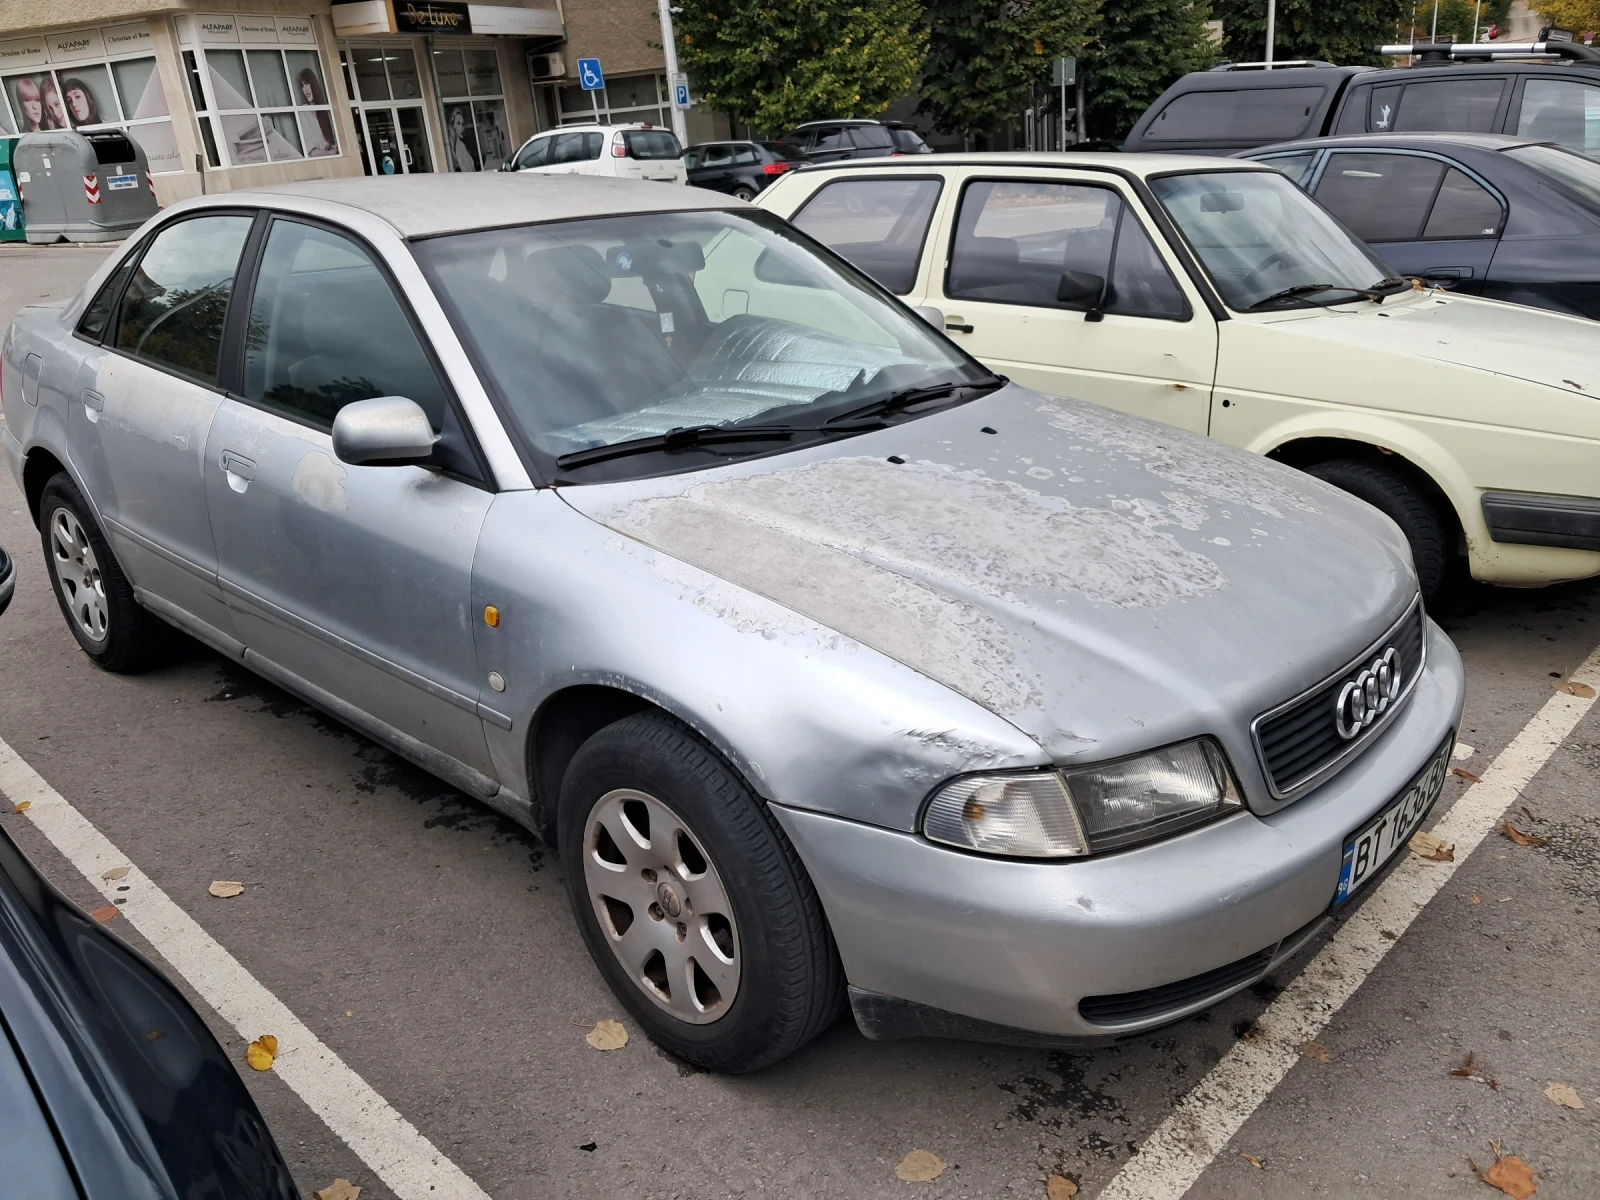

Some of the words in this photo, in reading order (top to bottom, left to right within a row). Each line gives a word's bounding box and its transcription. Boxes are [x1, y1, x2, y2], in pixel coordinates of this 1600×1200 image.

[407, 3, 426, 25] De
[428, 4, 458, 26] Luxe
[202, 23, 233, 31] ALFAPARF
[57, 39, 91, 50] ALFAPARF
[678, 87, 686, 103] P
[1353, 822, 1387, 885] BT
[1390, 774, 1430, 850] 1636
